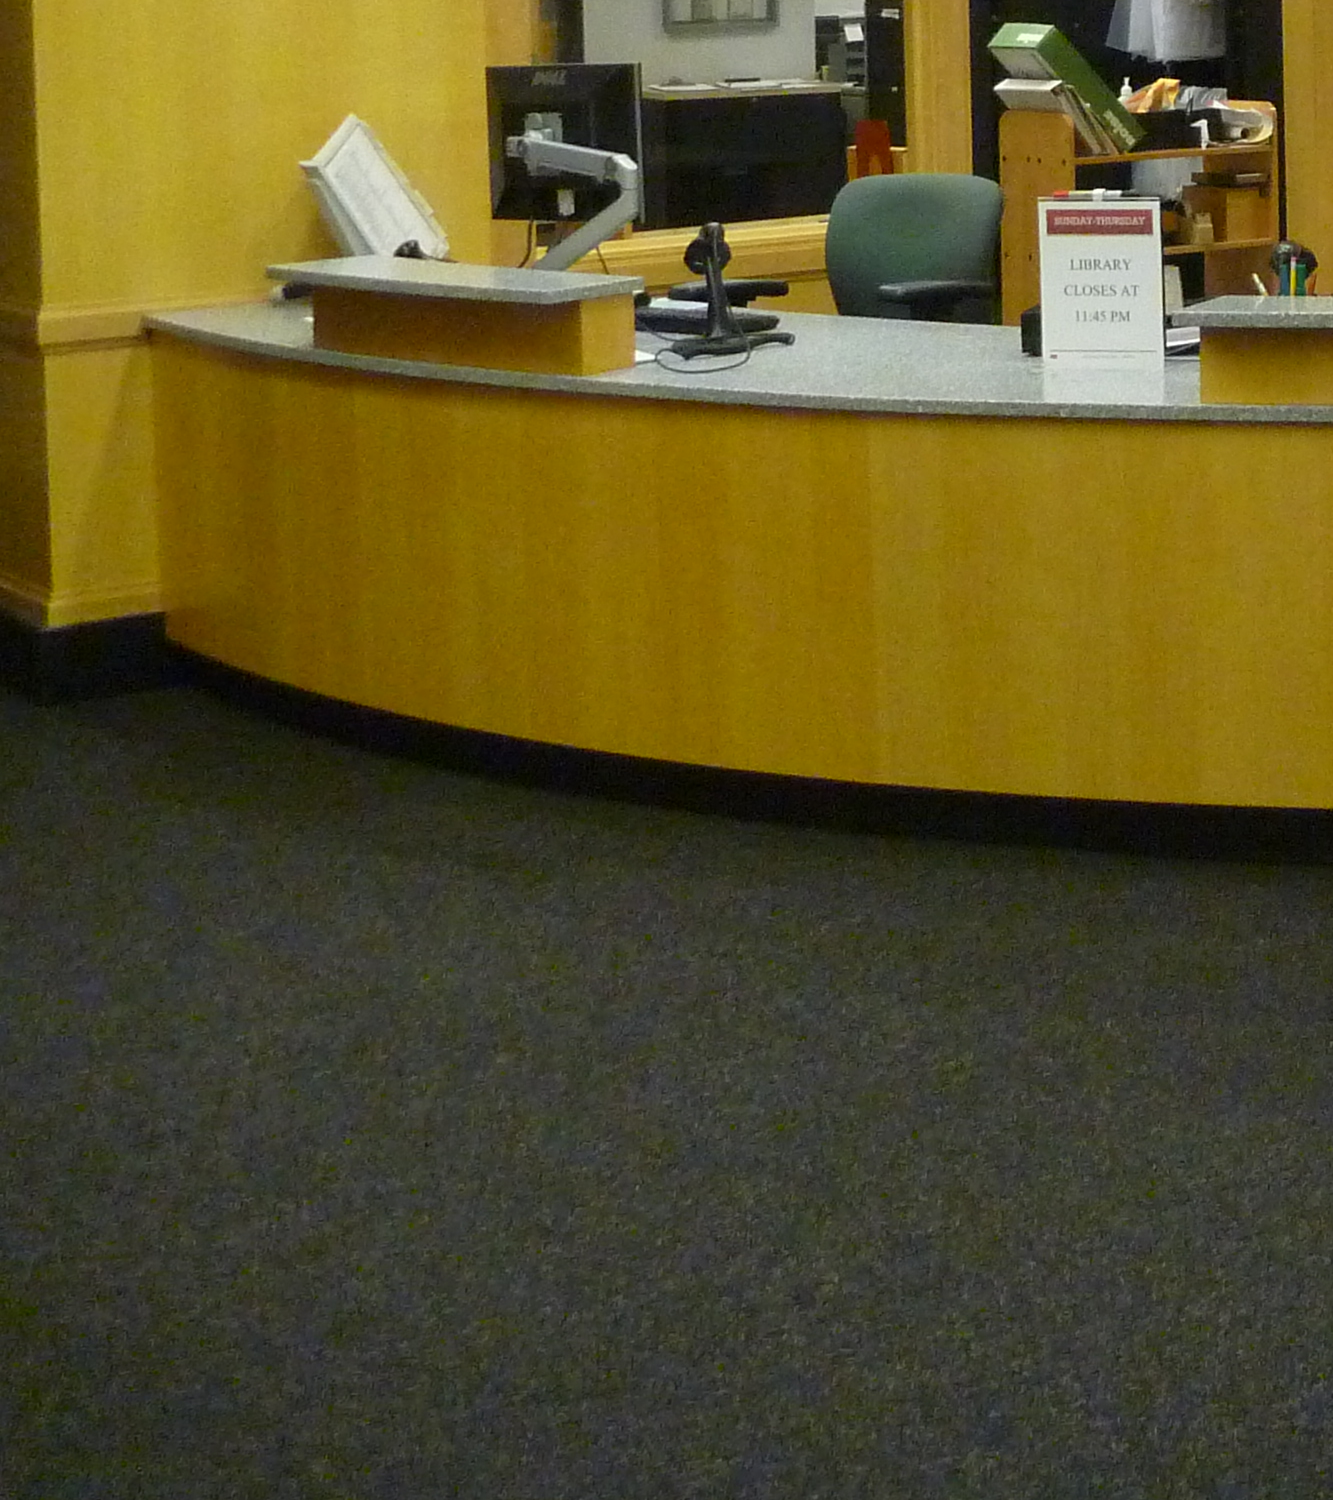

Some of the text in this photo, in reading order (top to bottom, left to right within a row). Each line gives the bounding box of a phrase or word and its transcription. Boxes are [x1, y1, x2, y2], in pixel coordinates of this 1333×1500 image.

[1069, 258, 1132, 271] LIBRARY
[1063, 284, 1140, 297] CLOSES AT
[1075, 310, 1131, 323] 11:45 PM
